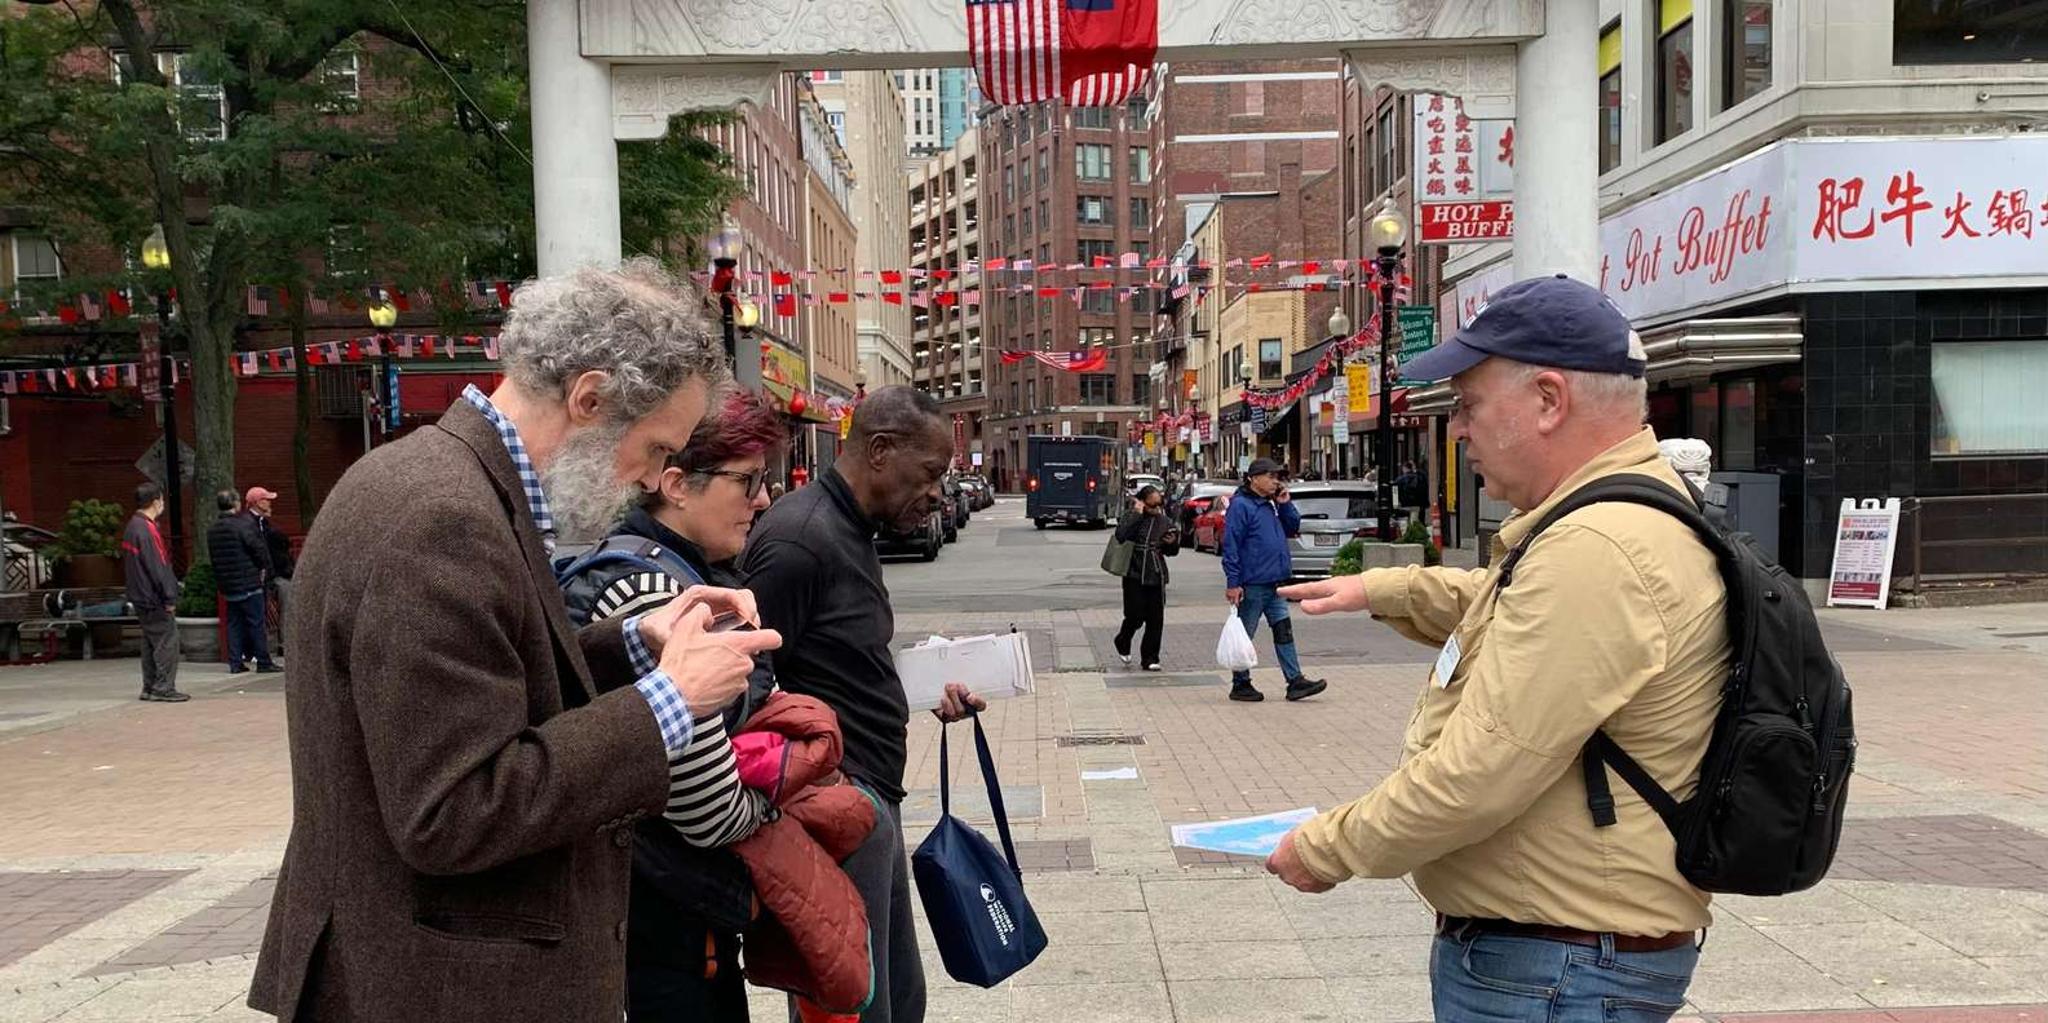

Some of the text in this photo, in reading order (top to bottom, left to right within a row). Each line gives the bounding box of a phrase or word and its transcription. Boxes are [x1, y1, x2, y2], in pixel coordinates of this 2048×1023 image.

[1433, 205, 1485, 223] HOT
[1621, 228, 1662, 291] Pot
[1674, 189, 1771, 284] Buffet
[987, 903, 1008, 946] FEDERATION
[996, 900, 1015, 932] NATIONAL
